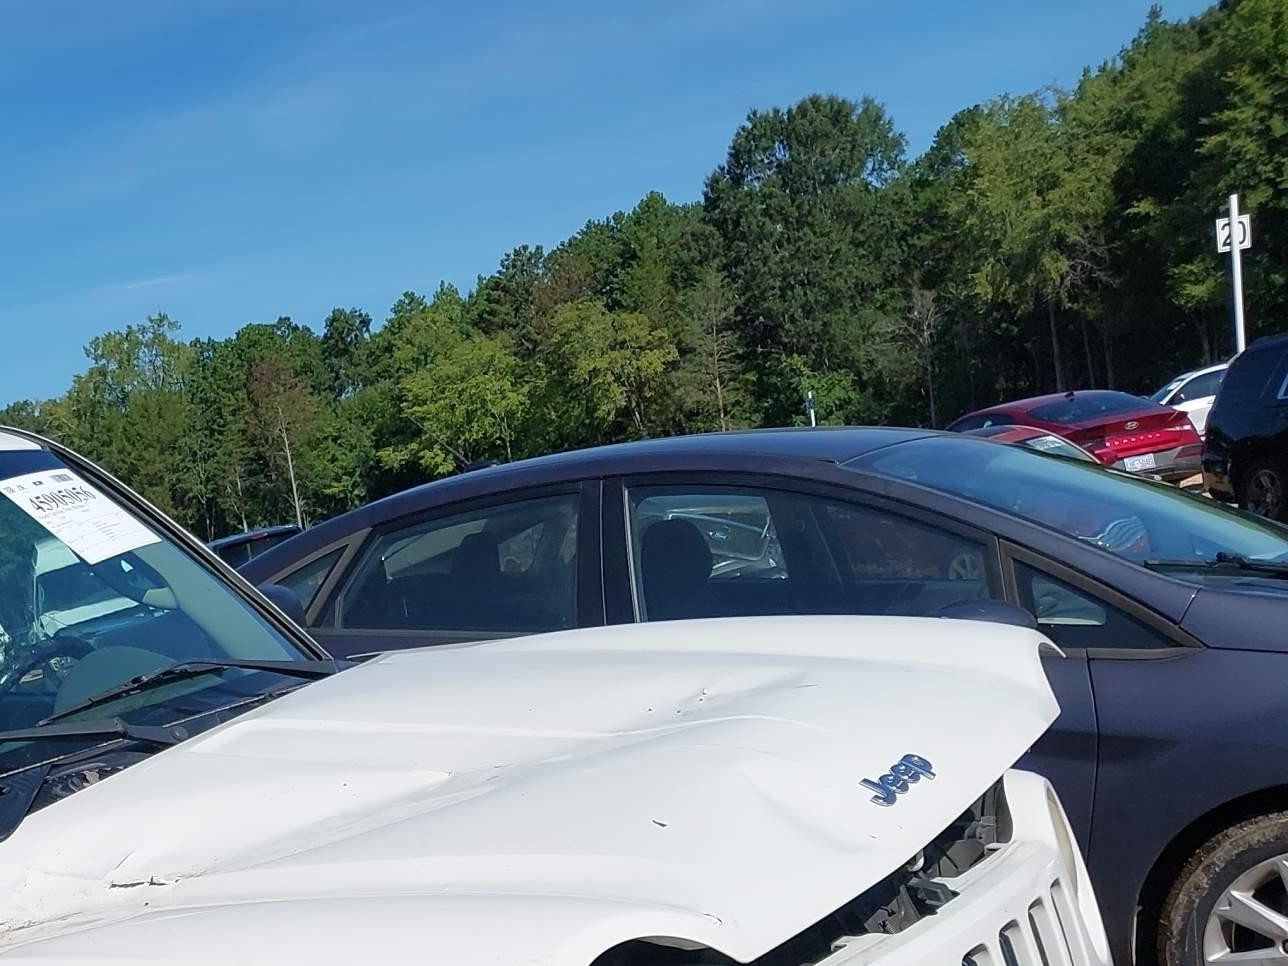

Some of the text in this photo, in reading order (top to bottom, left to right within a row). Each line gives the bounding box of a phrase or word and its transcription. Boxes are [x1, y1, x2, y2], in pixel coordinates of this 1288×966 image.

[1220, 220, 1247, 248] 20
[29, 485, 97, 513] 45905056
[857, 753, 937, 807] Jeep
